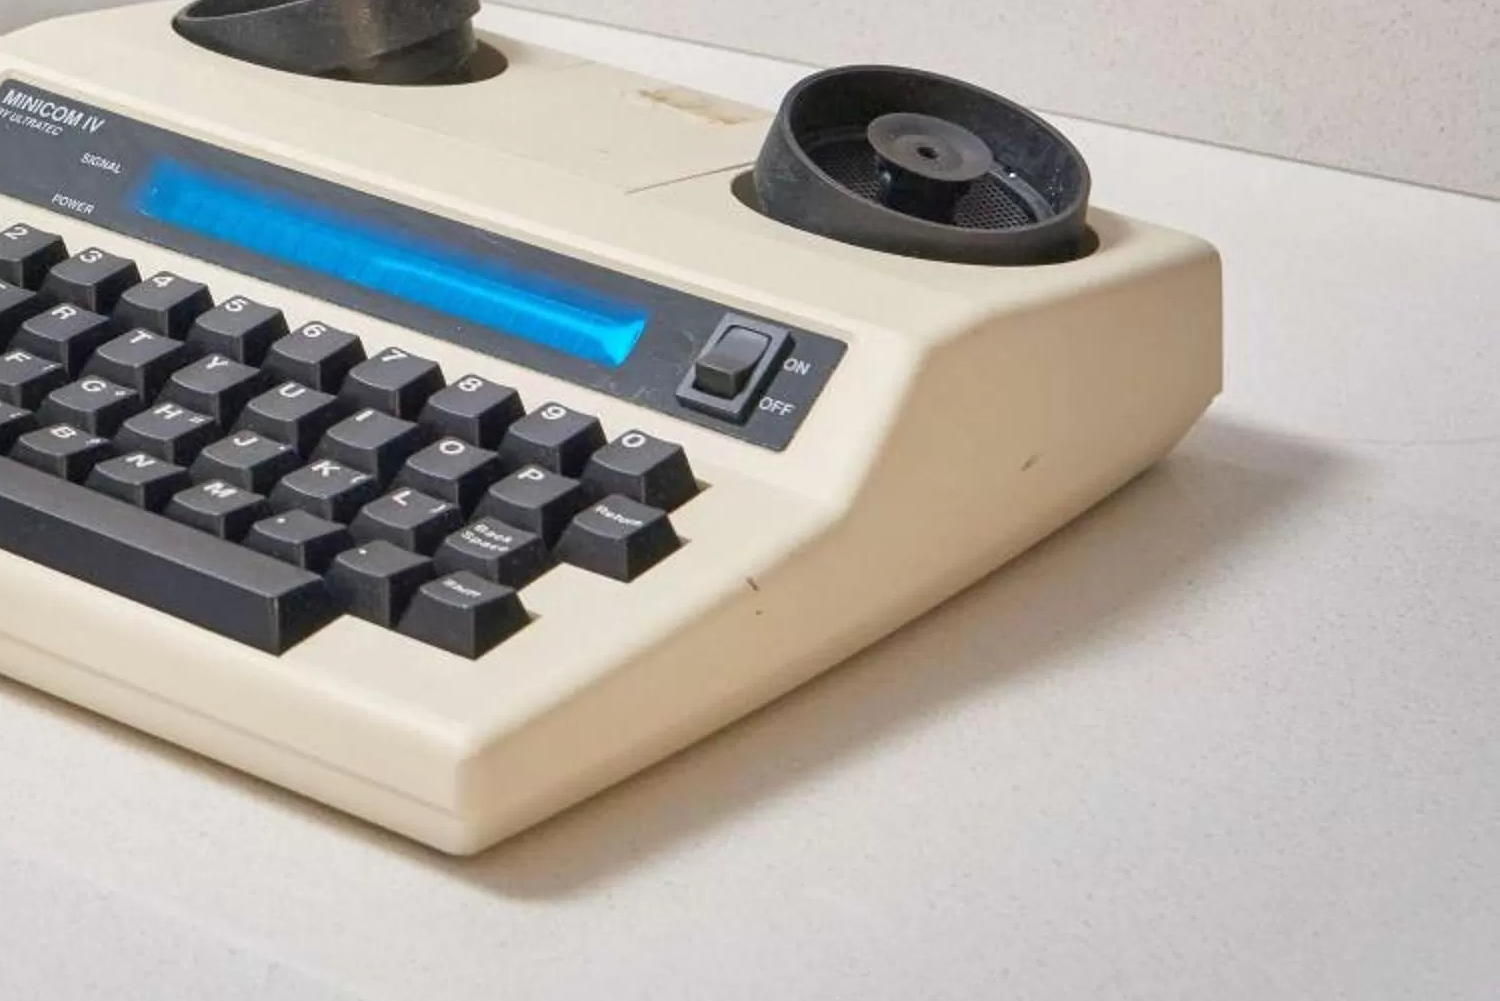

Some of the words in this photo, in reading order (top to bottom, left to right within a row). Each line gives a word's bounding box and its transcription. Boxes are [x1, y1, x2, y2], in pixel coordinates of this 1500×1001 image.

[1, 89, 83, 128] MINICOM
[82, 115, 106, 134] IV
[9, 112, 64, 136] ULTRATEC
[80, 152, 122, 175] SIGNAL
[51, 193, 94, 215] POWER
[4, 225, 29, 240] 2
[79, 249, 103, 264] 3
[151, 273, 175, 289] 4
[51, 303, 77, 321] R
[223, 296, 250, 313] 5
[128, 328, 155, 344] T
[301, 322, 328, 339] 6
[3, 350, 32, 364] F
[204, 354, 230, 370] Y
[381, 347, 407, 363] 7
[783, 357, 813, 376] ON
[80, 379, 107, 393] G
[278, 381, 307, 398] U
[457, 377, 484, 392] 8
[153, 402, 185, 420] H
[540, 405, 567, 420] 9
[758, 396, 796, 416] OFF
[51, 424, 78, 439] B
[233, 436, 260, 447] J
[126, 452, 157, 468] N
[311, 459, 342, 478] K
[517, 466, 545, 483] P
[203, 480, 238, 498] M
[391, 489, 414, 507] L
